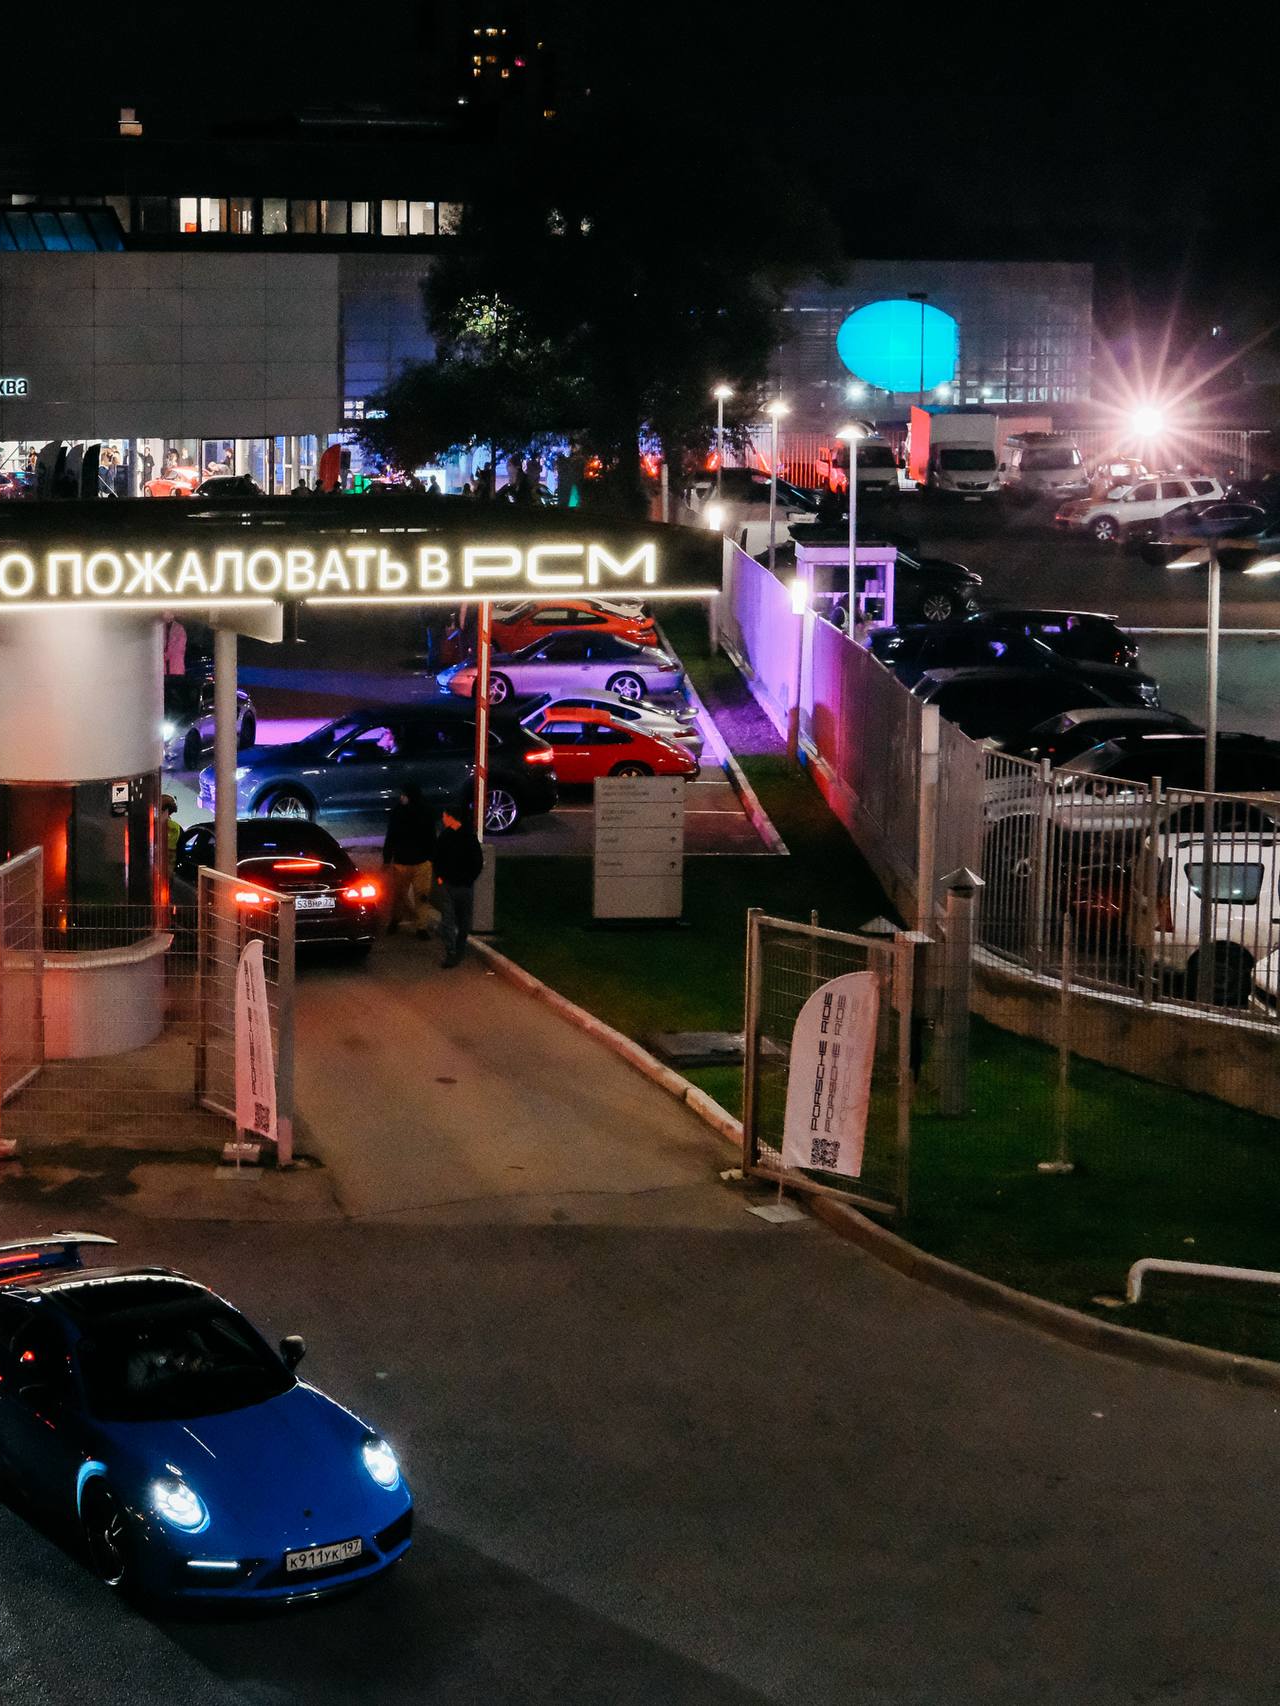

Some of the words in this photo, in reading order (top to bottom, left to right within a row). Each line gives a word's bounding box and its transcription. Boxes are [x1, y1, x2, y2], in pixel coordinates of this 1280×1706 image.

[47, 547, 409, 597] ПОЖАЛОВАТЬ
[420, 545, 450, 589] В
[810, 1040, 827, 1131] PORSCHE
[821, 992, 833, 1034] RIDE
[824, 1042, 841, 1133] PORSCHE
[834, 994, 847, 1036] RIDE
